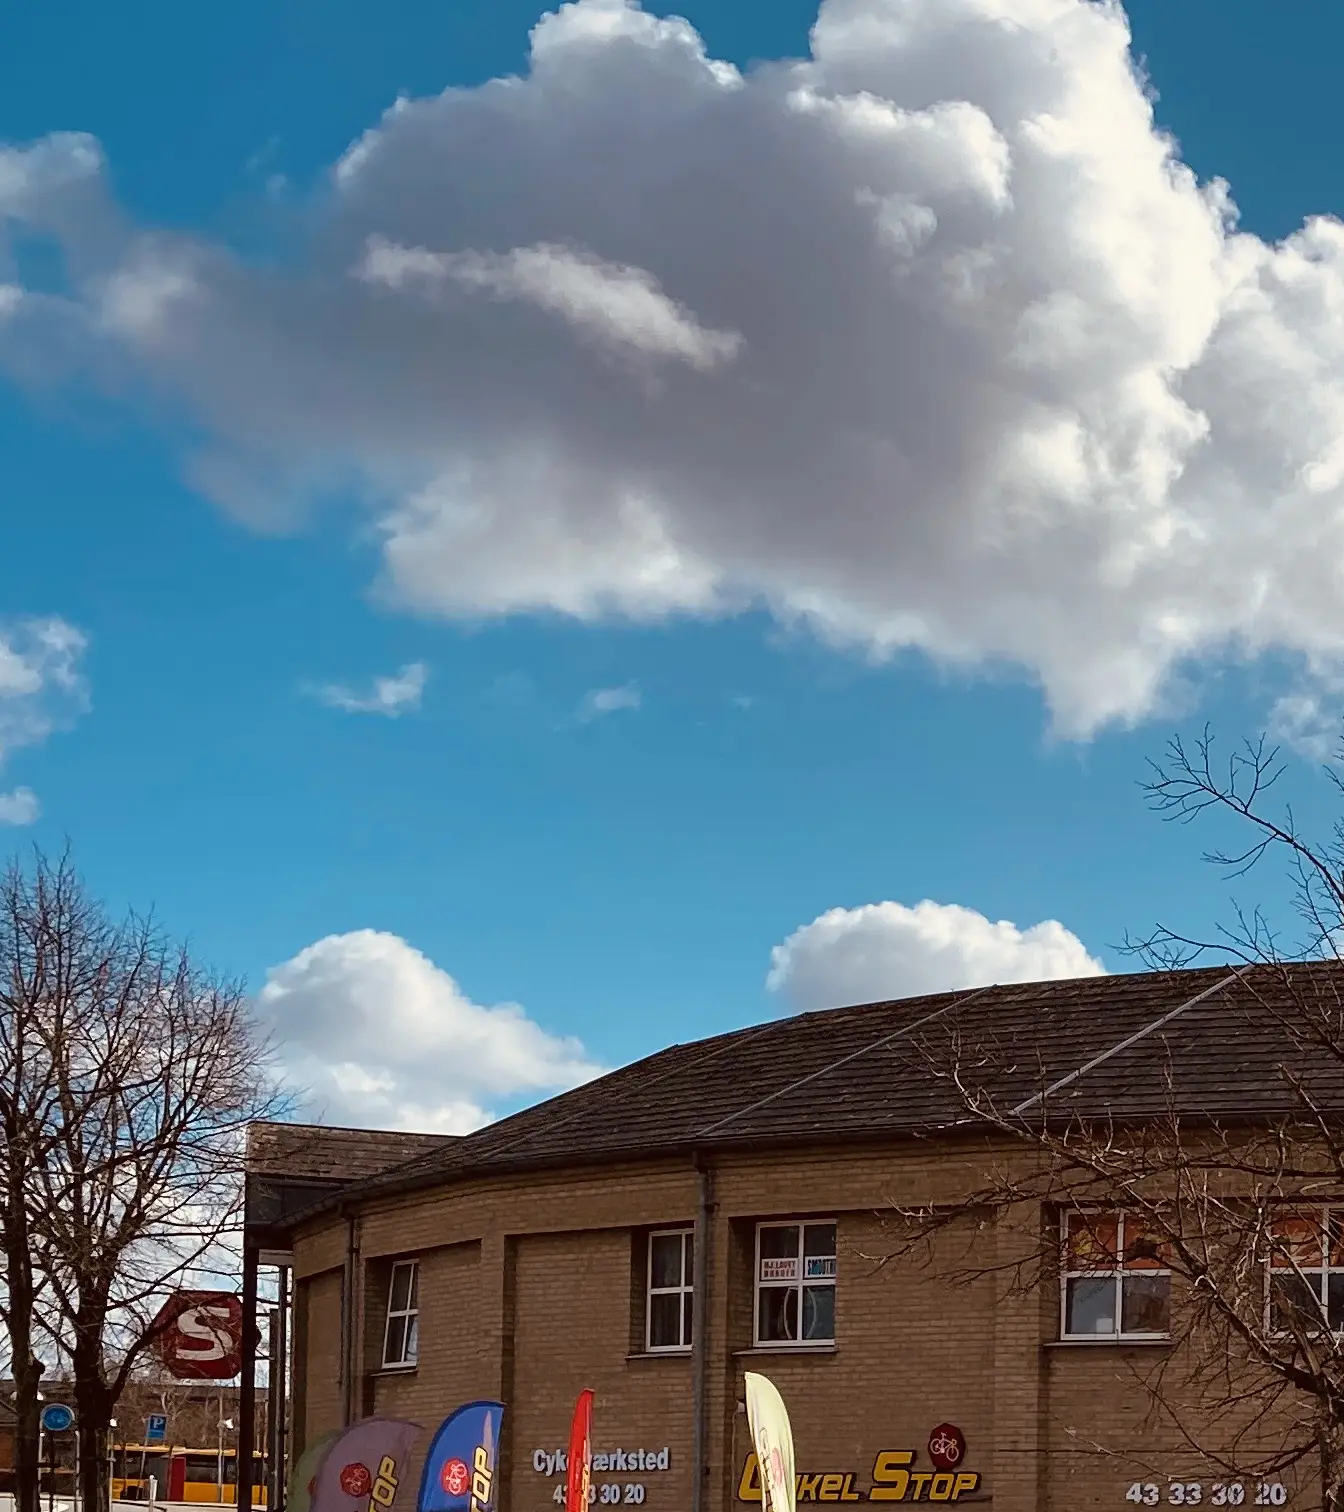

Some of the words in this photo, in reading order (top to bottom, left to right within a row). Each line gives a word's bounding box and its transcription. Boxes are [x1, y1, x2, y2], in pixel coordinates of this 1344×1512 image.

[175, 1306, 233, 1361] S
[152, 1418, 164, 1430] P
[533, 1447, 669, 1476] Cykærksted
[737, 1451, 861, 1503] CKEL
[868, 1450, 982, 1503] STOP
[600, 1484, 621, 1504] 30
[623, 1483, 645, 1504] 20
[1125, 1482, 1160, 1506] 43
[1168, 1482, 1203, 1506] 33
[1211, 1483, 1246, 1506] 30
[1254, 1483, 1288, 1506] 20
